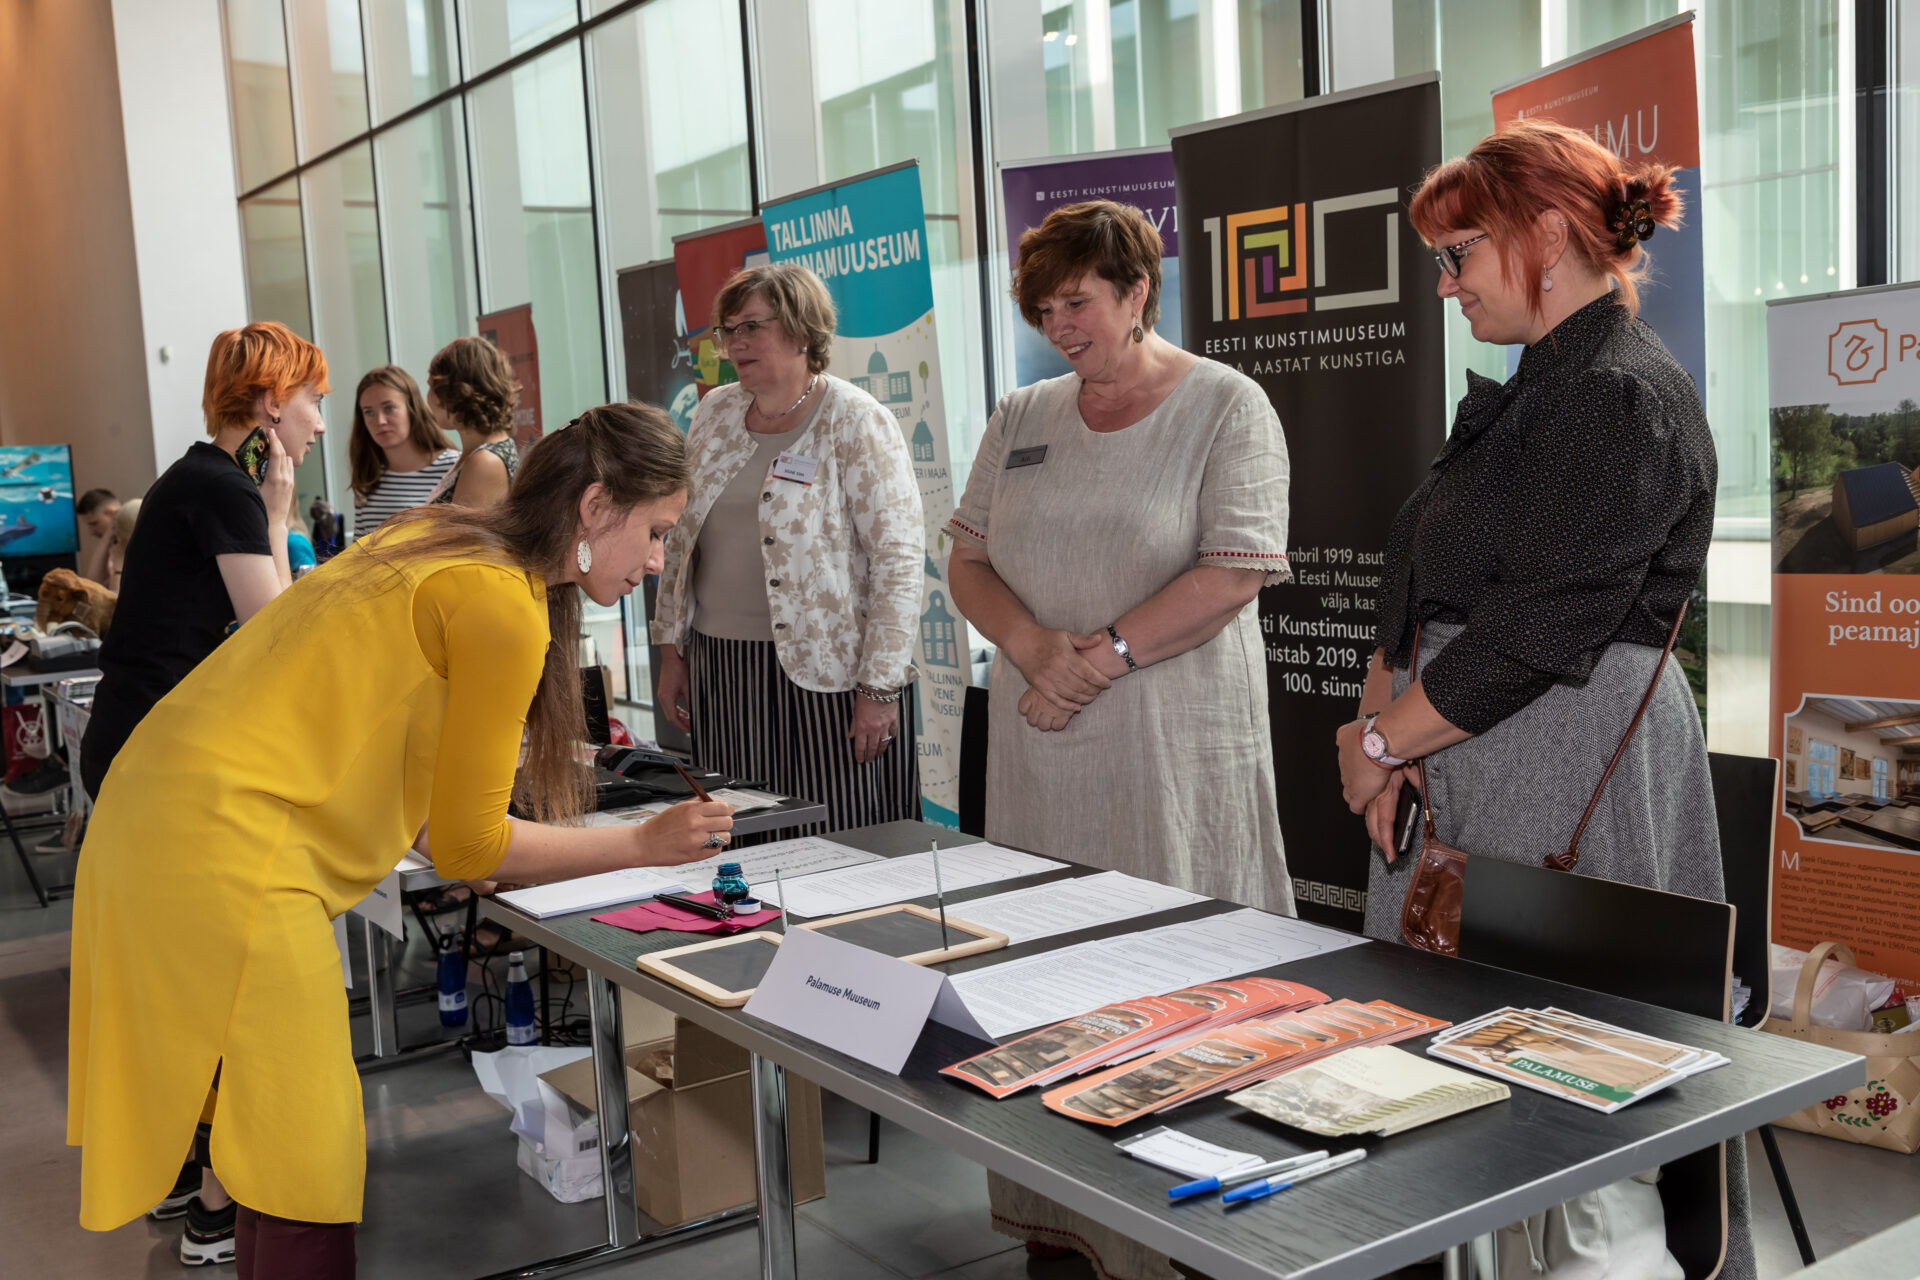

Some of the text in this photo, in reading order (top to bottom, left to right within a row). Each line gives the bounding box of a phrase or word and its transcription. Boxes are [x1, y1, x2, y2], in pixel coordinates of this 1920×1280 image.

[1050, 180, 1175, 199] EESTI KUNSTIMUUSEUM
[770, 204, 854, 252] TALLINNA
[1205, 321, 1406, 354] EESTI KUNSTIMUUSEUM
[1253, 357, 1311, 375] AASTAT
[1320, 349, 1406, 370] KUNSTIGA
[1323, 548, 1353, 564] 1919
[1357, 551, 1385, 565] asut
[1300, 570, 1330, 586] Eesti
[1321, 592, 1350, 614] välja
[1825, 590, 1883, 613] Sind
[1828, 620, 1920, 649] peamaj
[1316, 646, 1360, 669] 2019.
[1282, 672, 1316, 694] 100.
[805, 975, 880, 1010] Palamuse Muuseum
[1513, 1060, 1600, 1091] PALAMUSE
